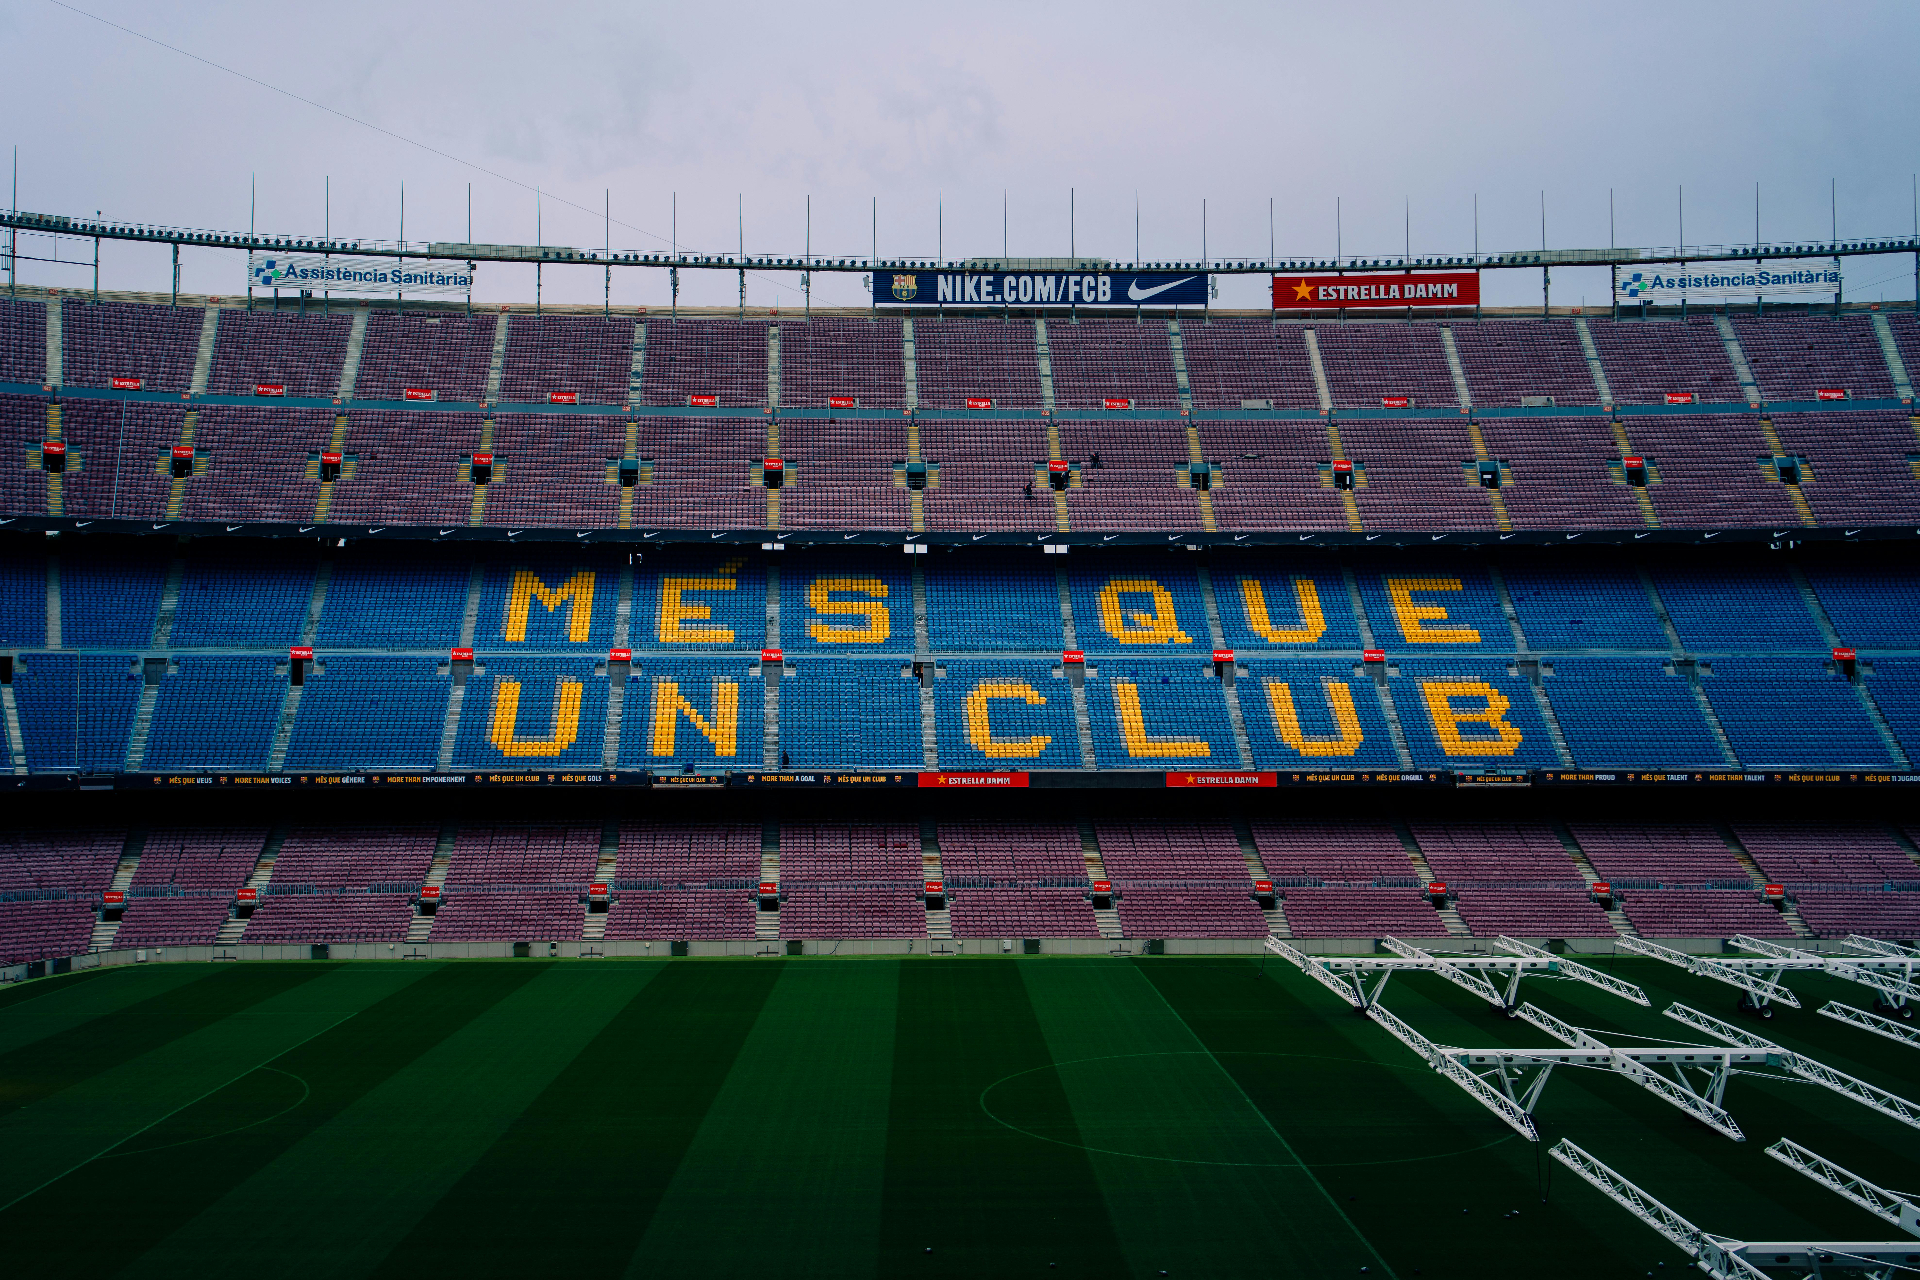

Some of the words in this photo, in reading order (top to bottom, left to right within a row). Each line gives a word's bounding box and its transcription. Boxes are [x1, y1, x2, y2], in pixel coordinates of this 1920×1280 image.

[284, 263, 388, 283] Assistència
[390, 269, 468, 286] Sanitària
[1651, 273, 1756, 289] Assistència
[1758, 269, 1840, 286] Sanitària
[938, 275, 1112, 302] NIKE.COM/FCB
[1318, 284, 1401, 300] ESTRELLA
[1404, 283, 1458, 299] DAMM
[505, 557, 892, 644] MÉS
[1099, 579, 1482, 644] QUE
[490, 681, 739, 758] UN
[966, 682, 1524, 758] CLUB
